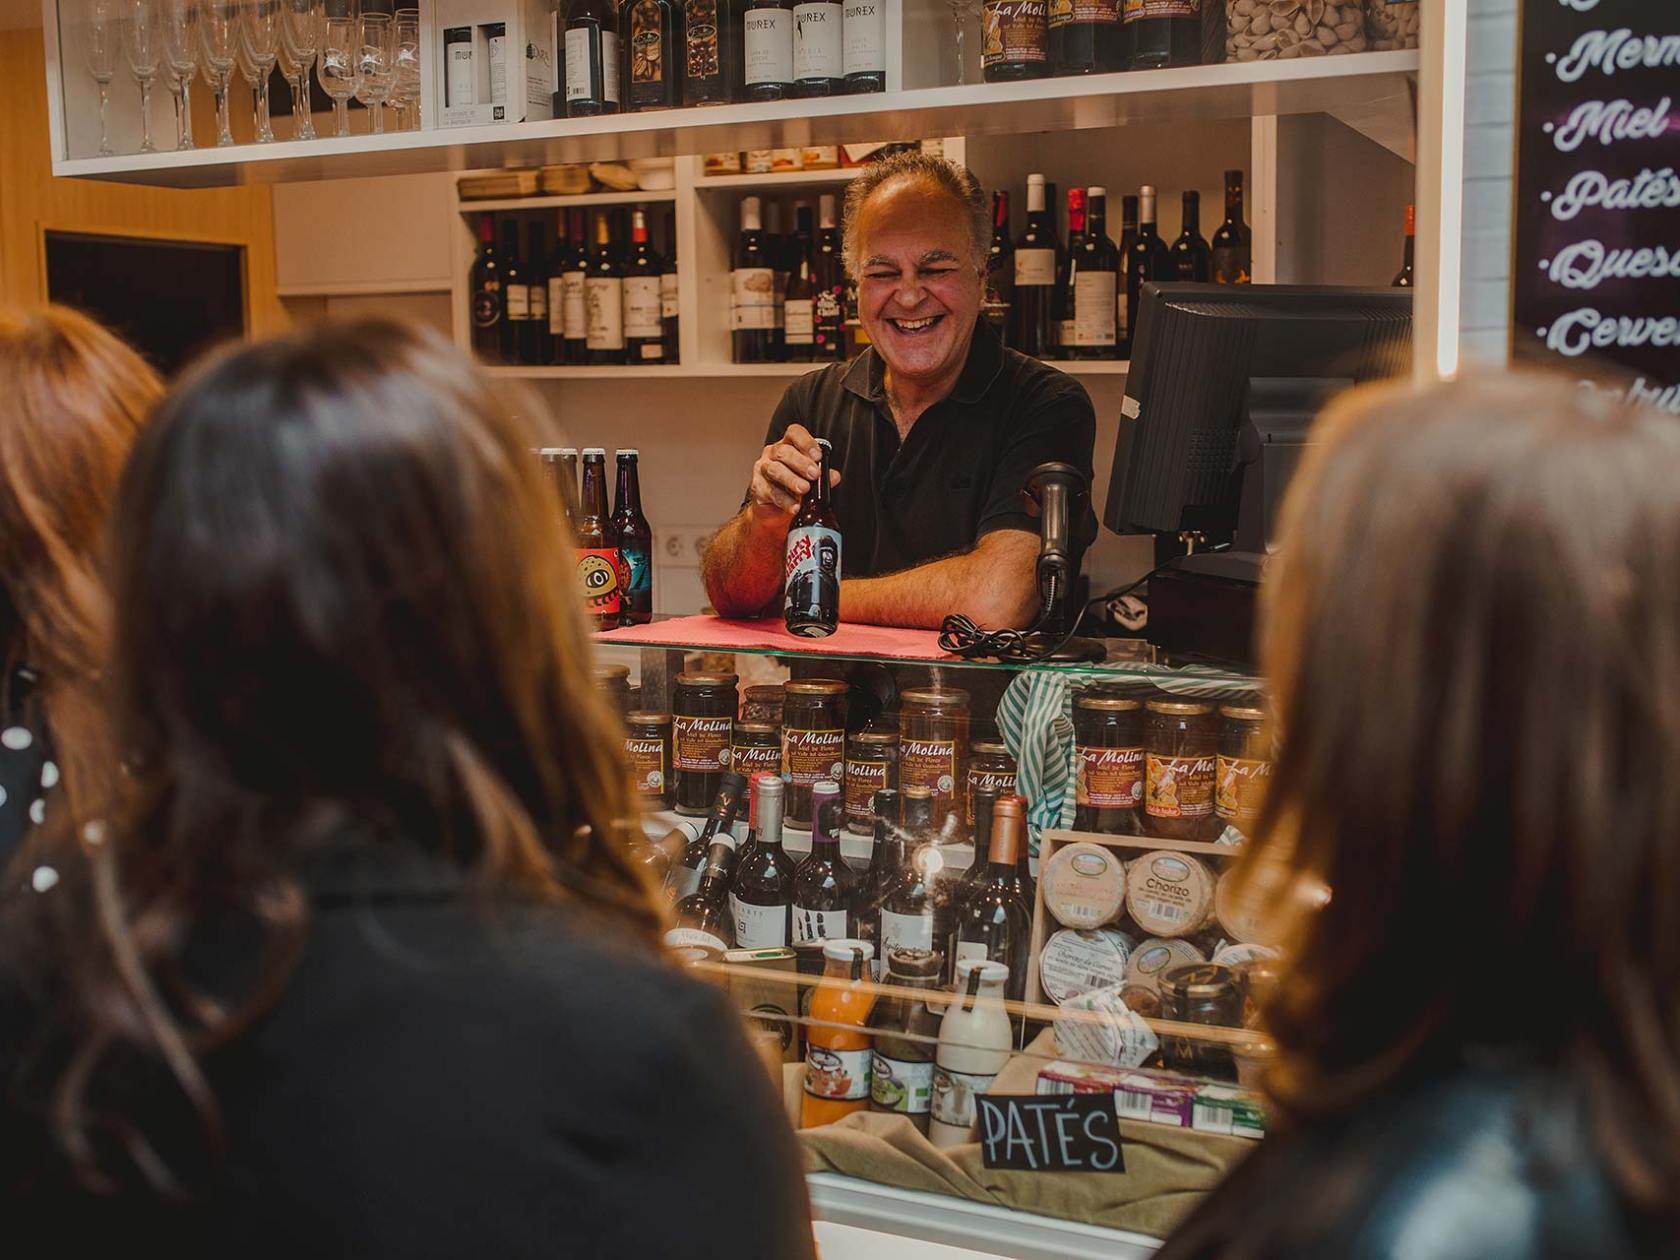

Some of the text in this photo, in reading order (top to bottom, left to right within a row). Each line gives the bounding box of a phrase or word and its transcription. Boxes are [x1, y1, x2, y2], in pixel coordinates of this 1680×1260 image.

[1553, 96, 1671, 152] Miel
[1551, 167, 1680, 221] Patés
[1146, 878, 1190, 897] Chorizo
[981, 1098, 1119, 1171] PATÉS
